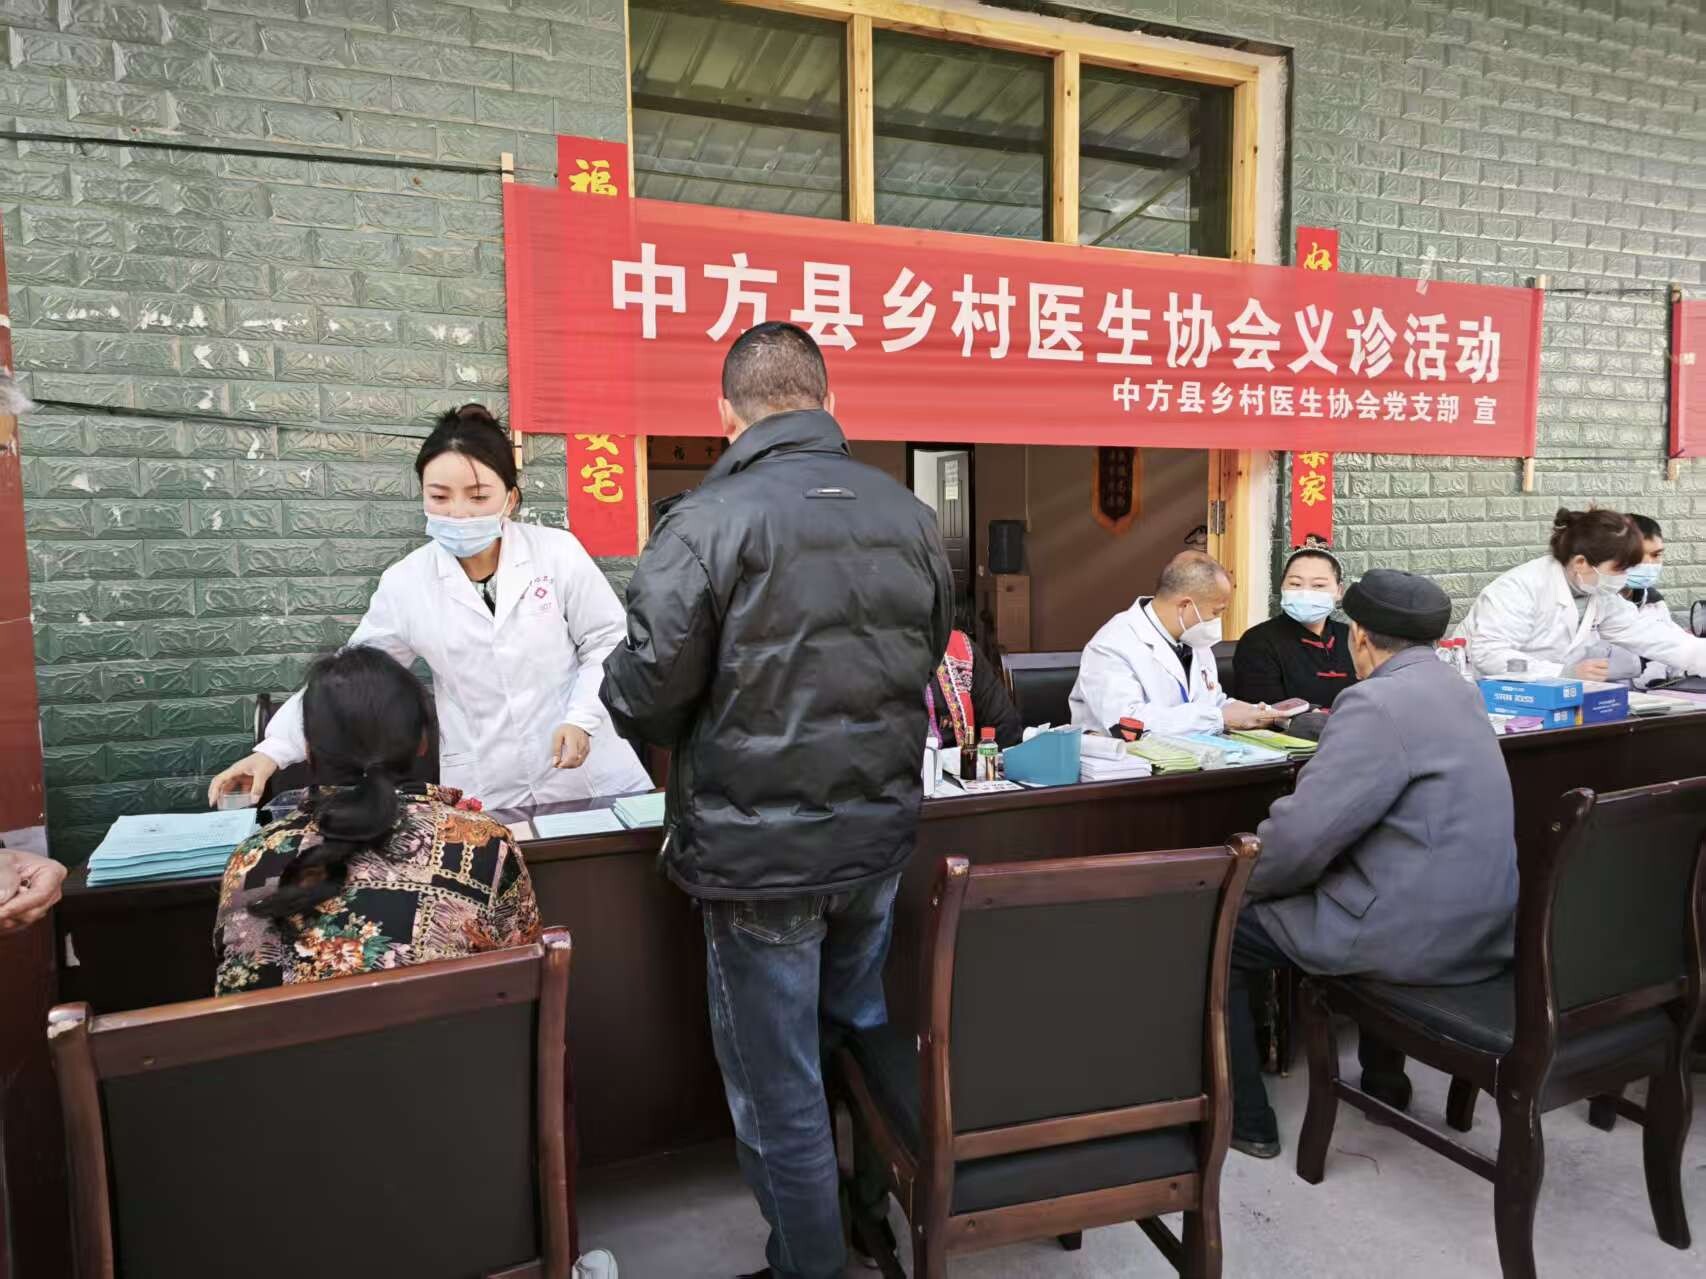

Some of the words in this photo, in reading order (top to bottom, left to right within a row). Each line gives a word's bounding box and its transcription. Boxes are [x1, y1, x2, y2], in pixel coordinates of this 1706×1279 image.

[568, 158, 618, 195] 福
[611, 241, 1501, 385] 中方县乡村医生协会义诊活动
[1113, 377, 1460, 424] 中方县乡村医生协会党支部
[1473, 395, 1497, 425] 宣
